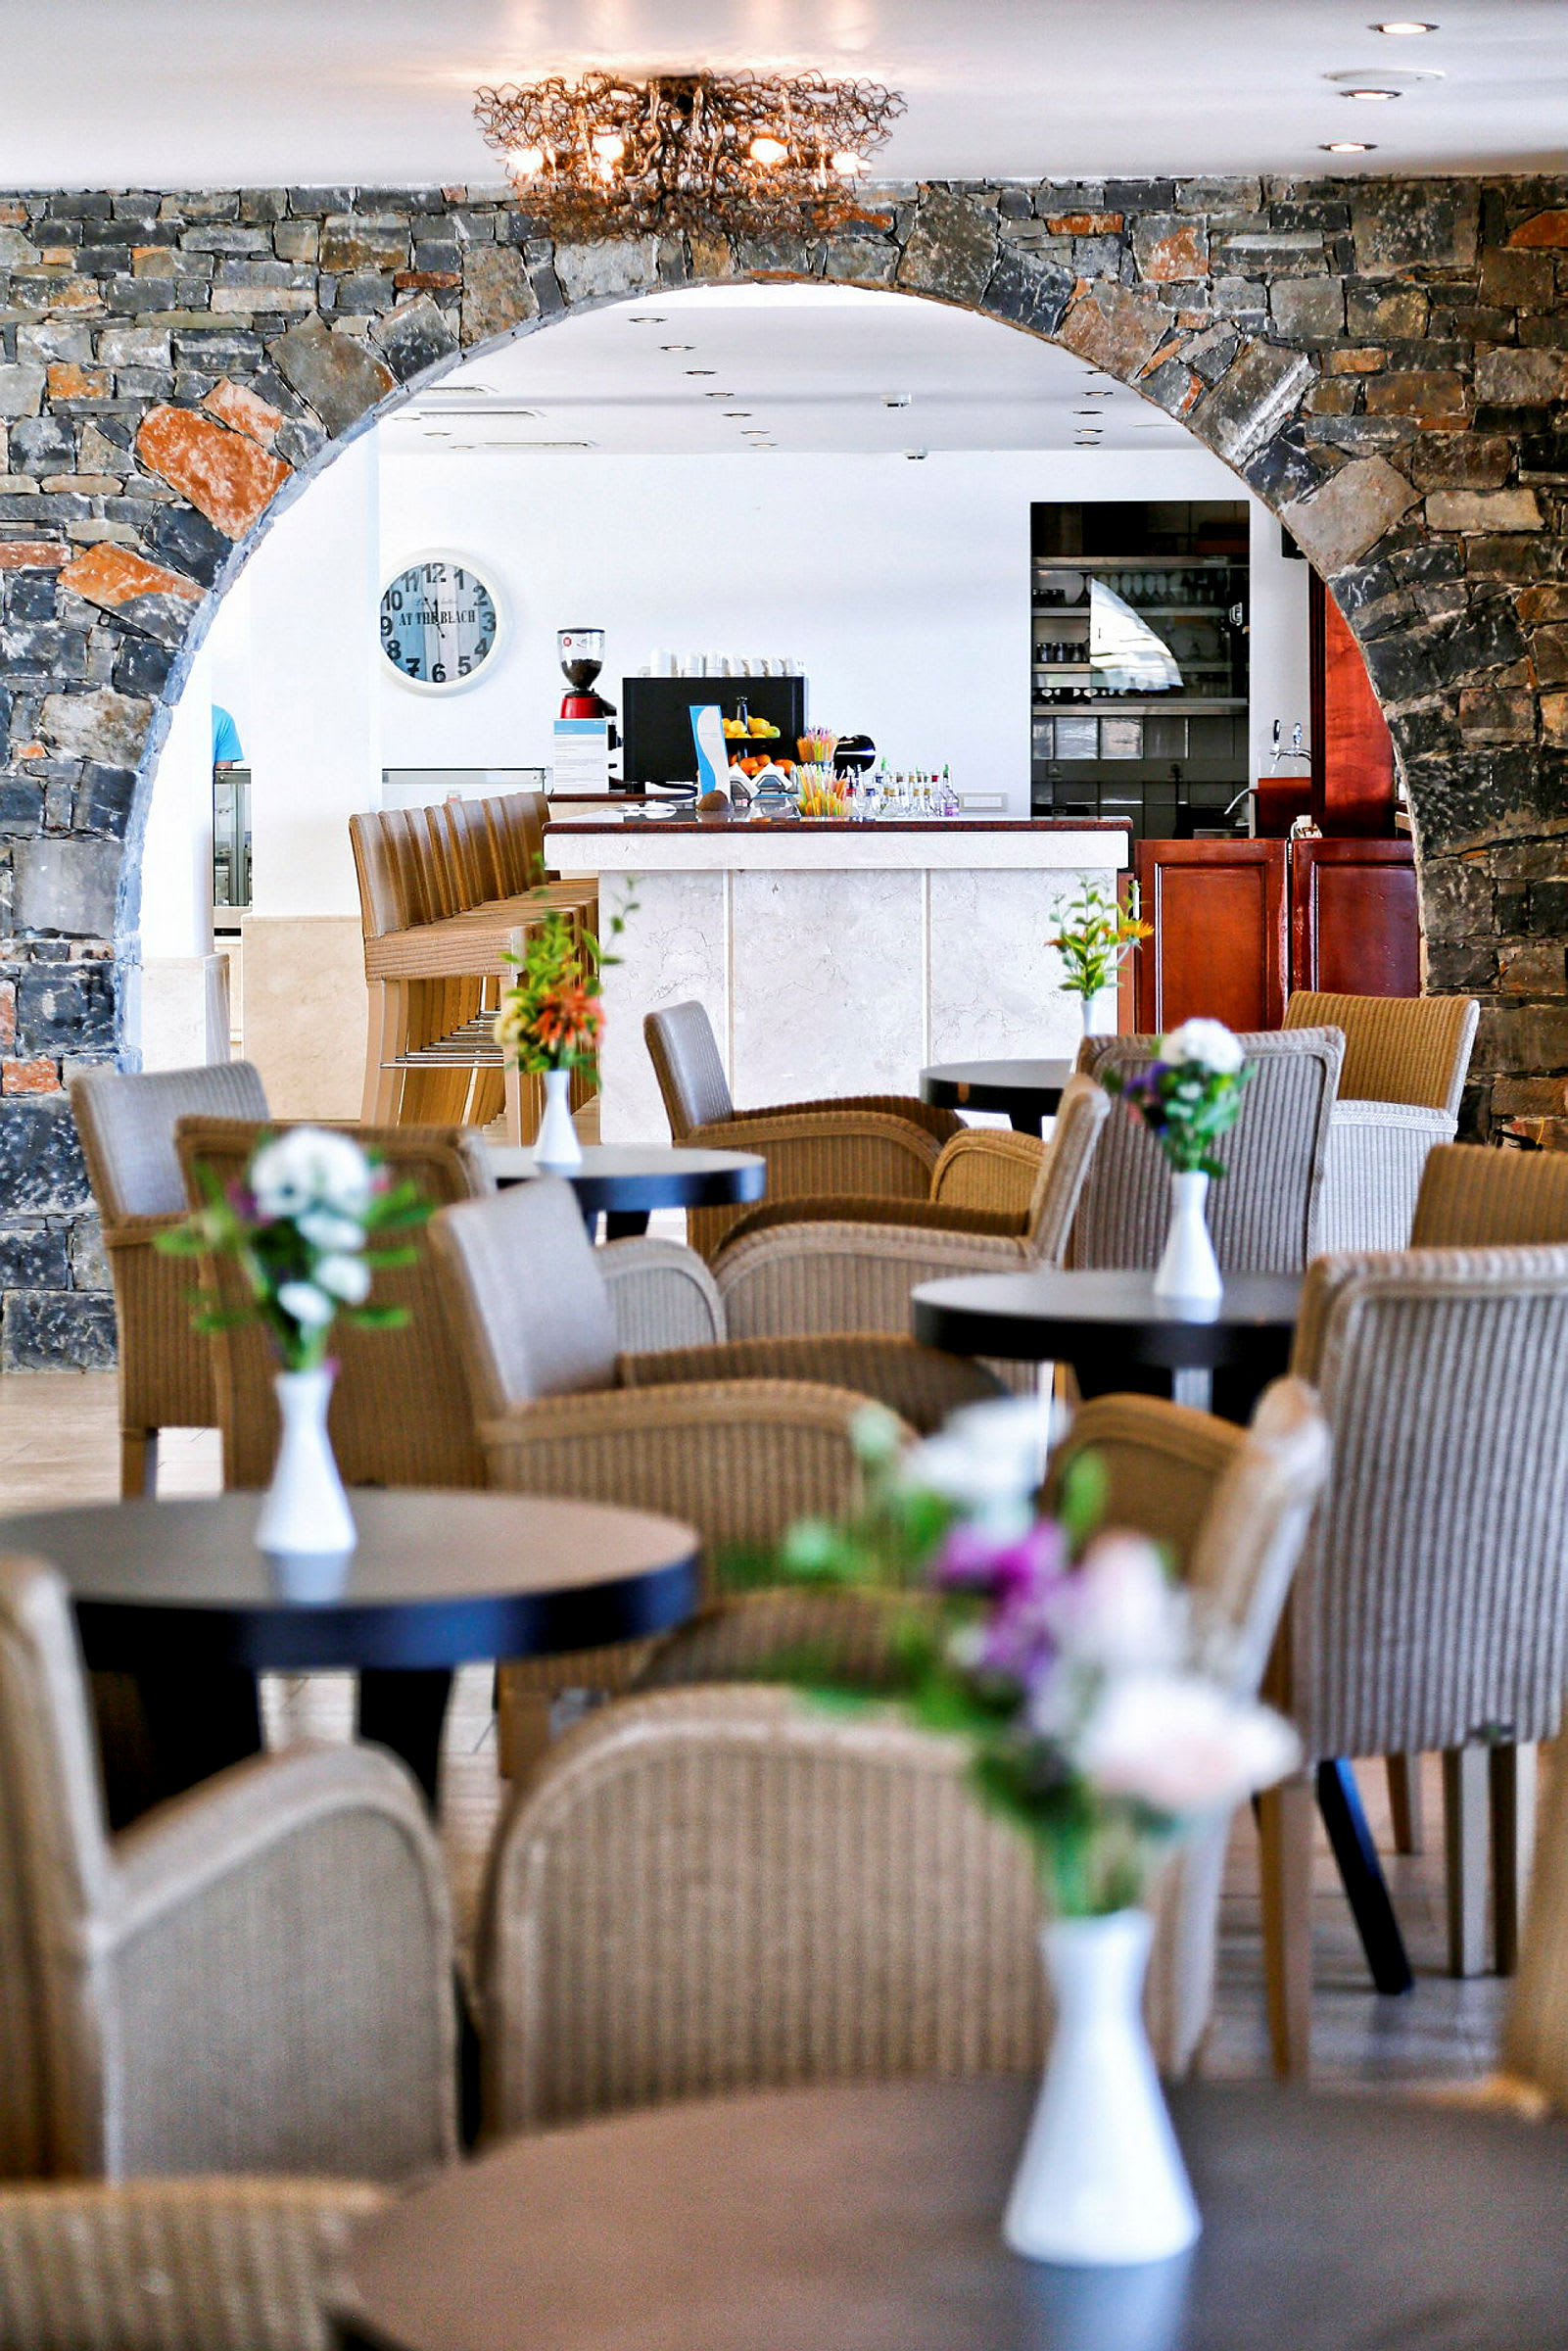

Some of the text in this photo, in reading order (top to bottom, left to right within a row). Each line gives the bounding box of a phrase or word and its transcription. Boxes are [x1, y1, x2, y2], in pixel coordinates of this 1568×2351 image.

[421, 563, 447, 583] 12
[453, 568, 464, 590] 1
[382, 589, 403, 611] 10
[473, 585, 488, 606] 2
[381, 615, 393, 637] 9
[399, 612, 412, 626] AT
[440, 609, 475, 624] BEACH
[482, 611, 497, 632] 3
[387, 640, 402, 661] 8
[474, 638, 489, 659] 4
[405, 657, 420, 678] 7
[432, 663, 447, 683] 6
[457, 655, 471, 676] 5
